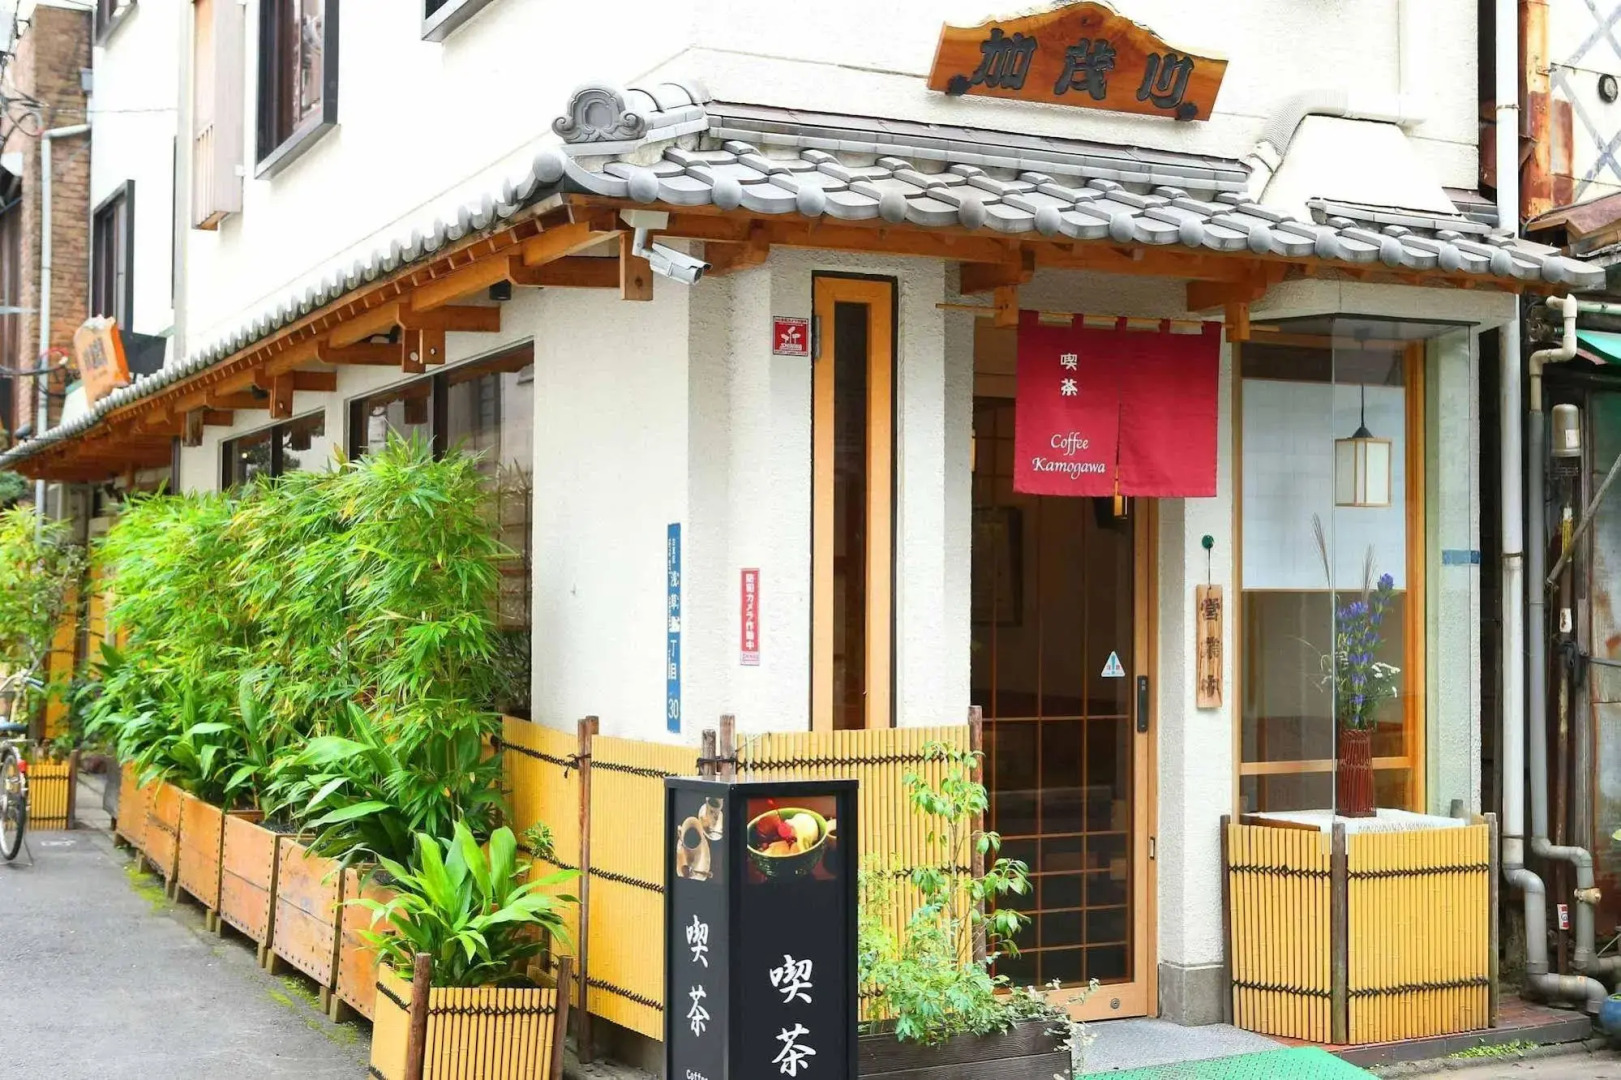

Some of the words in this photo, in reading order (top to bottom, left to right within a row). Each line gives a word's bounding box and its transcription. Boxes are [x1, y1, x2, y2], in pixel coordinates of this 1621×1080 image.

[970, 26, 1196, 110] 加茂川
[1060, 352, 1078, 397] 喫茶
[1050, 431, 1089, 456] Coffee
[1031, 456, 1106, 480] Kamogawa
[668, 697, 679, 720] 30
[685, 914, 710, 1038] 喫茶
[769, 954, 817, 1078] 喫茶
